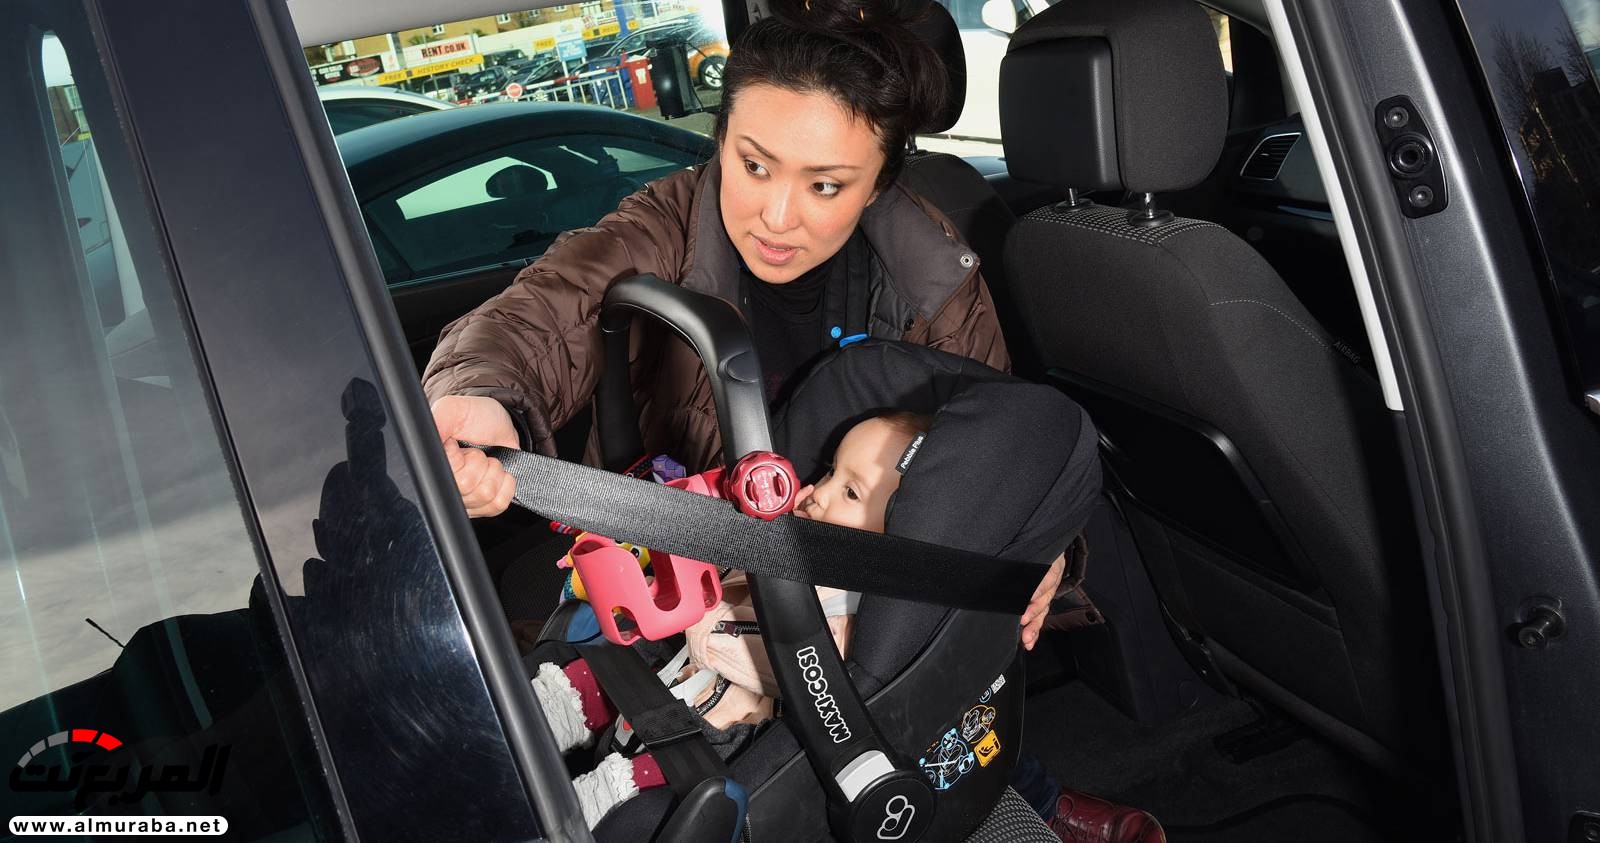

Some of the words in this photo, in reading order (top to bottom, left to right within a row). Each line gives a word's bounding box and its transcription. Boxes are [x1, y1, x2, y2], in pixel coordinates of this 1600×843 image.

[421, 42, 466, 59] RENT.CO.UK
[417, 61, 449, 74] HISTORY
[450, 57, 474, 68] CHECK
[900, 448, 916, 469] Pebble
[912, 435, 924, 449] Plus
